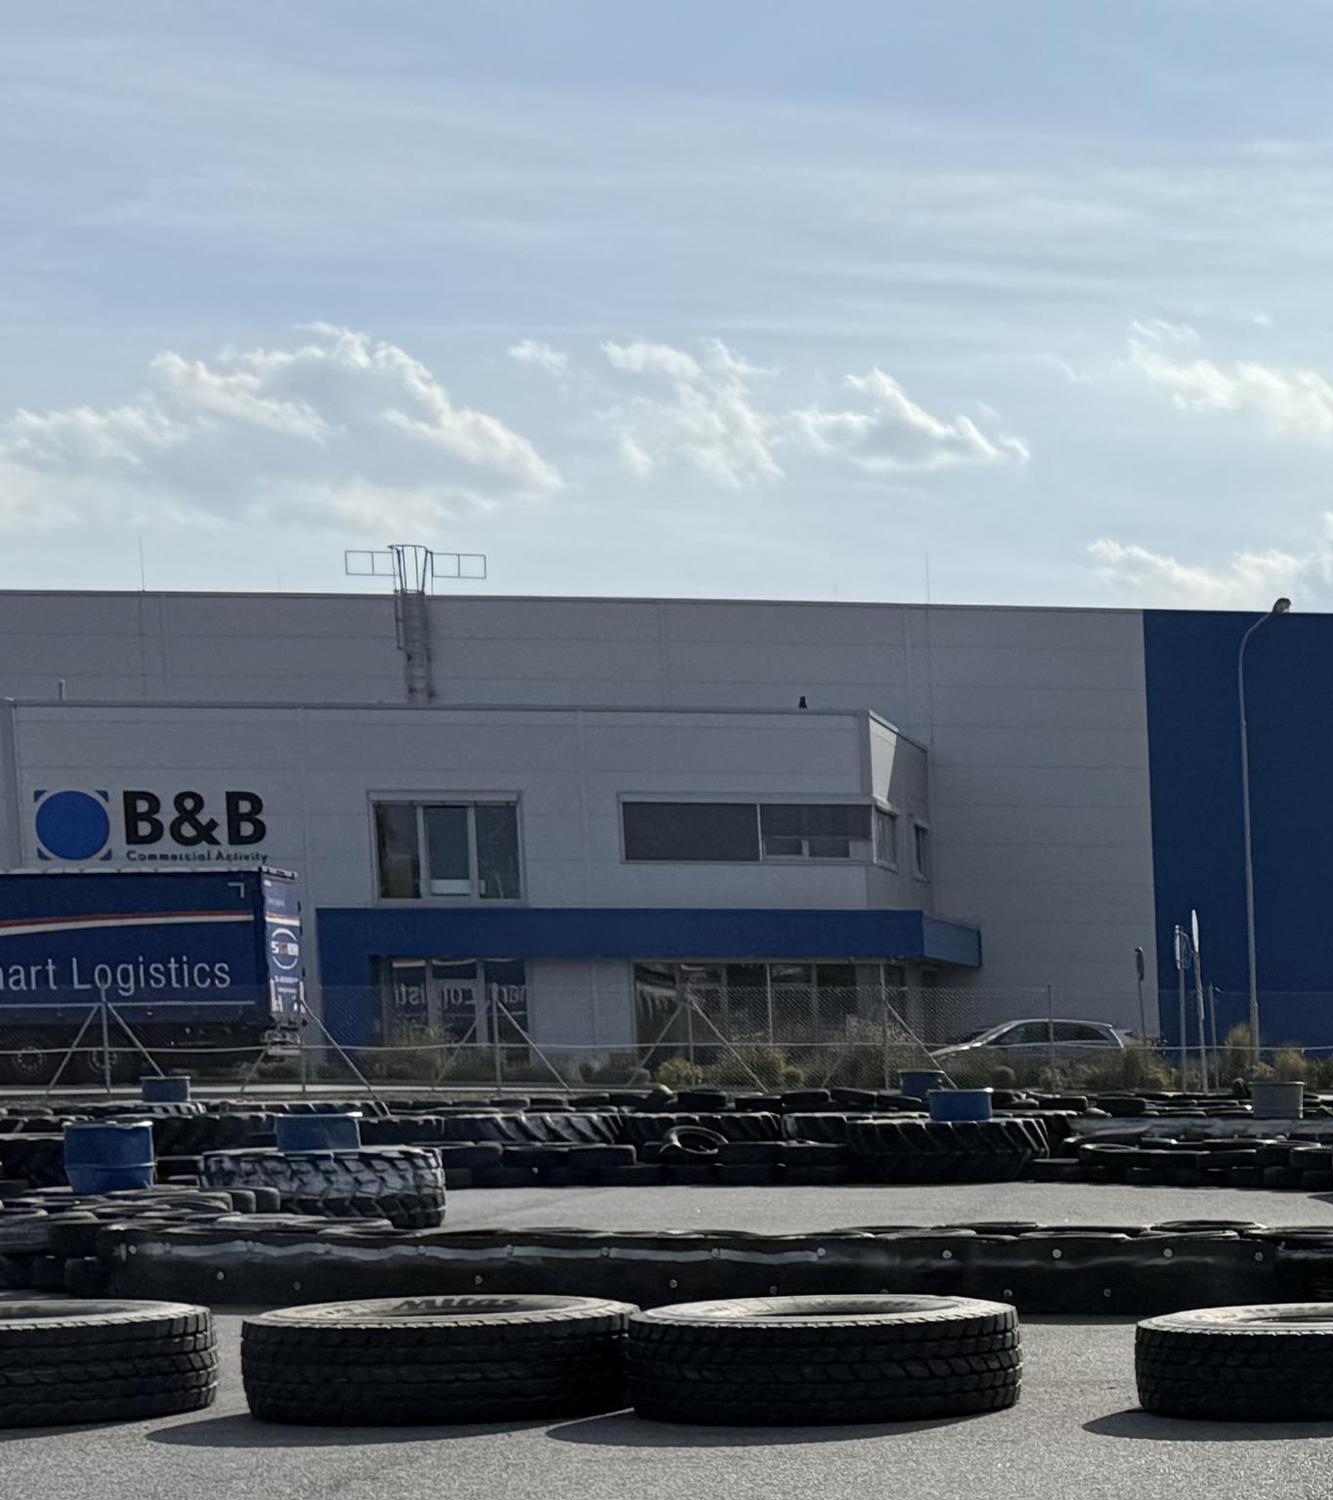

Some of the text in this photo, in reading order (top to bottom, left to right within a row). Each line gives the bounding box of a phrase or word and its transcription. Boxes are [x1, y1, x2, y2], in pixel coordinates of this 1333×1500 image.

[123, 790, 267, 847] B&B
[126, 850, 269, 865] Commercial Activity
[73, 955, 231, 997] Logistics
